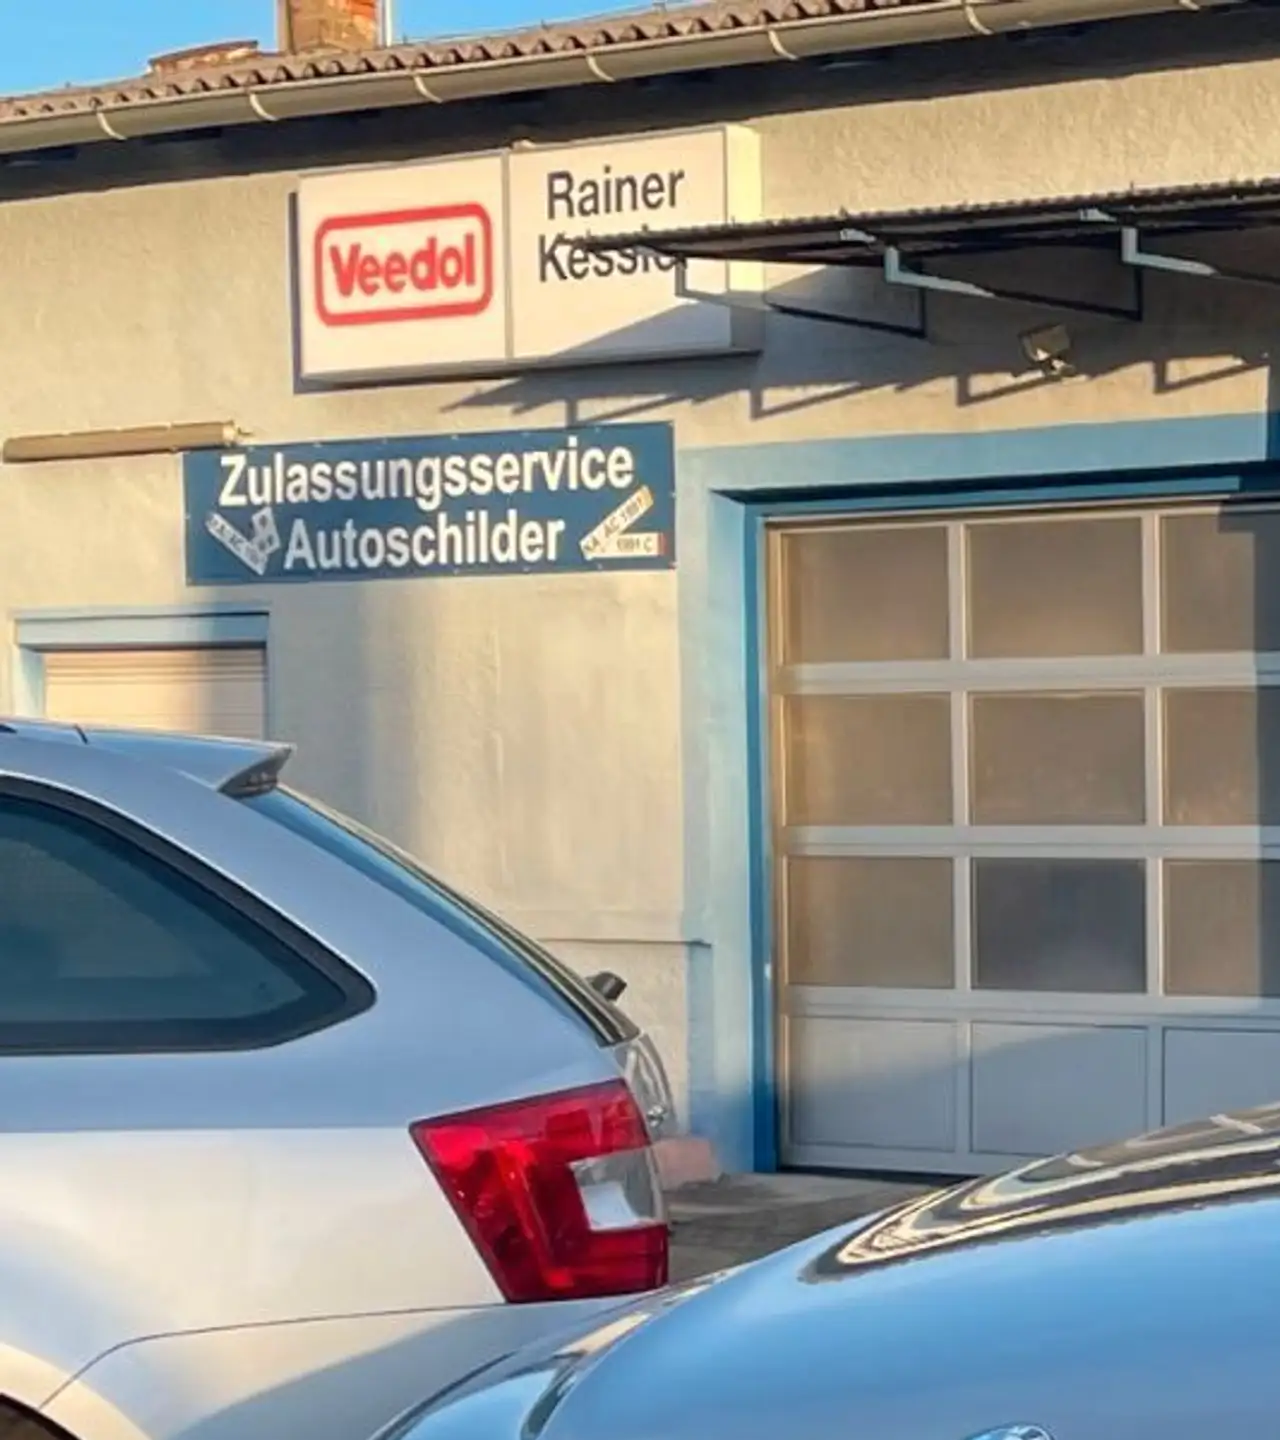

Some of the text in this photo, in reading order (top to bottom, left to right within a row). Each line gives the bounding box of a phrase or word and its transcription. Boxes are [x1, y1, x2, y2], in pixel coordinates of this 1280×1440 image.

[546, 164, 686, 220] Rainer
[328, 232, 476, 298] Veedol
[218, 435, 635, 512] Zulassungsservice
[283, 507, 566, 571] Autoschilder
